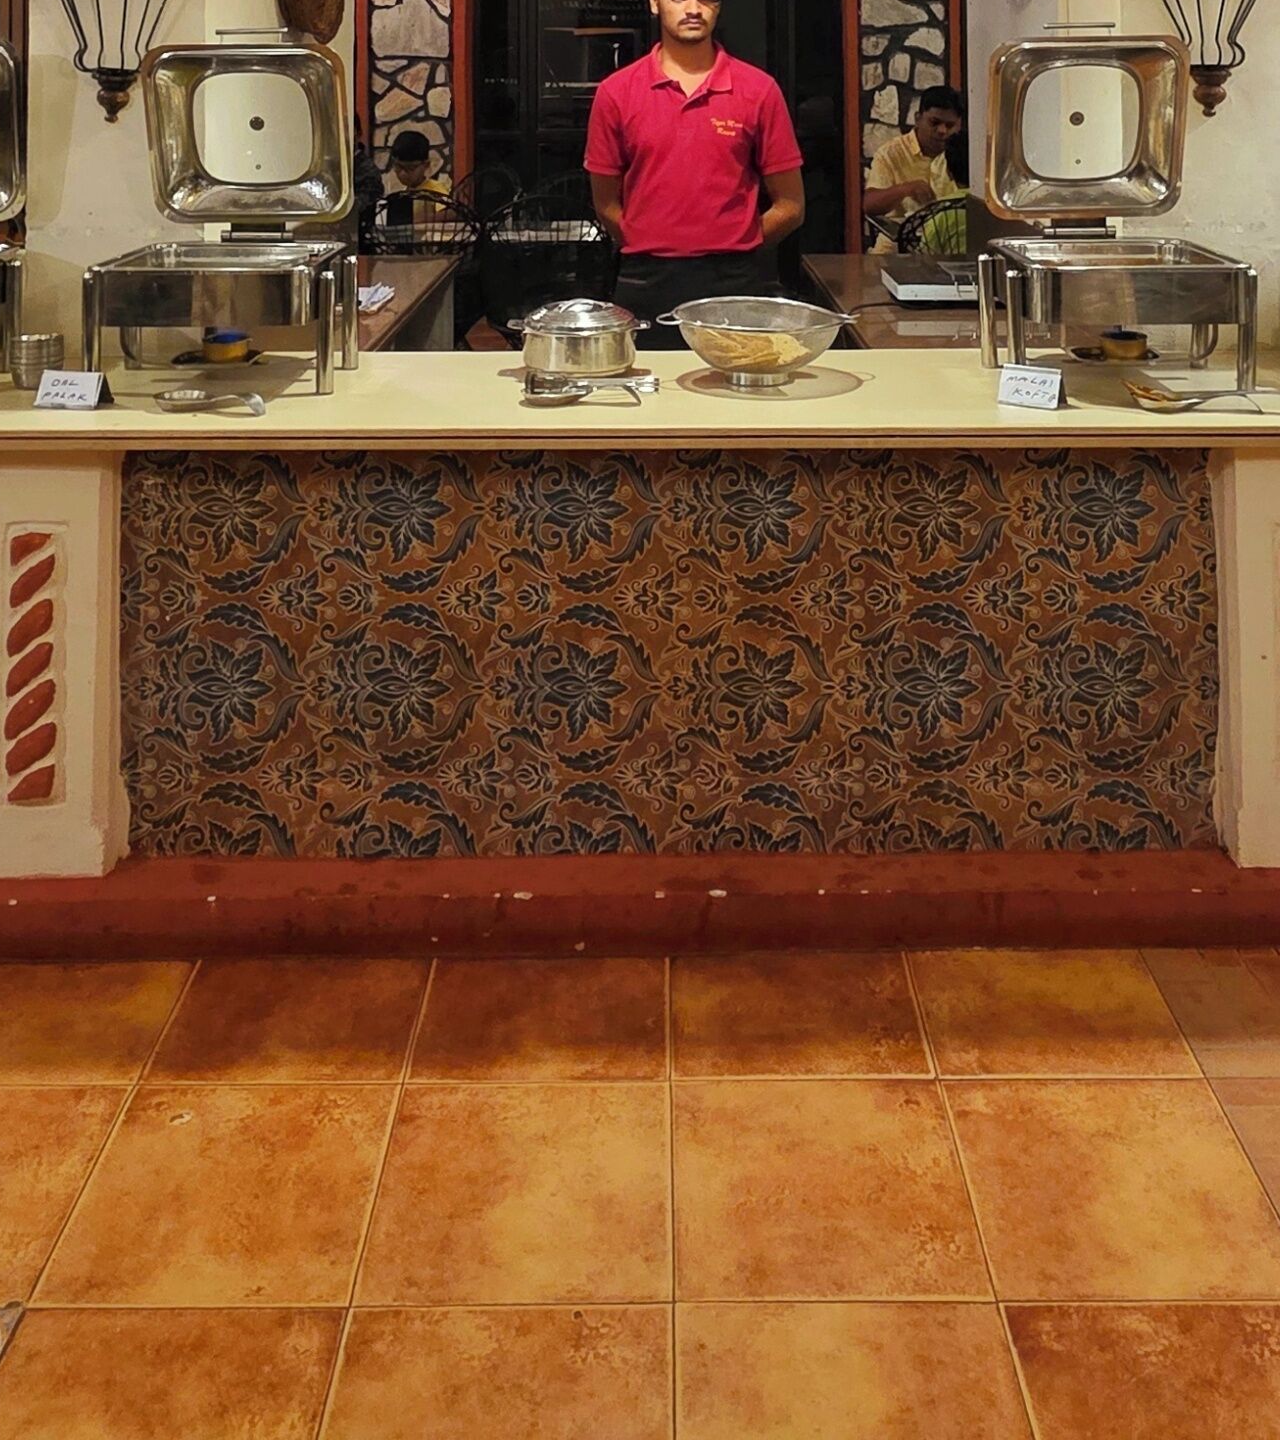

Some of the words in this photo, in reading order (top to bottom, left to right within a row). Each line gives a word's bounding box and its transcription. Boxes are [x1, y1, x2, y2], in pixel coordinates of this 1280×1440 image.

[51, 378, 79, 387] DAL
[1006, 375, 1054, 388] MALAI
[41, 391, 88, 402] PALAK
[1012, 387, 1057, 403] KOFTA
